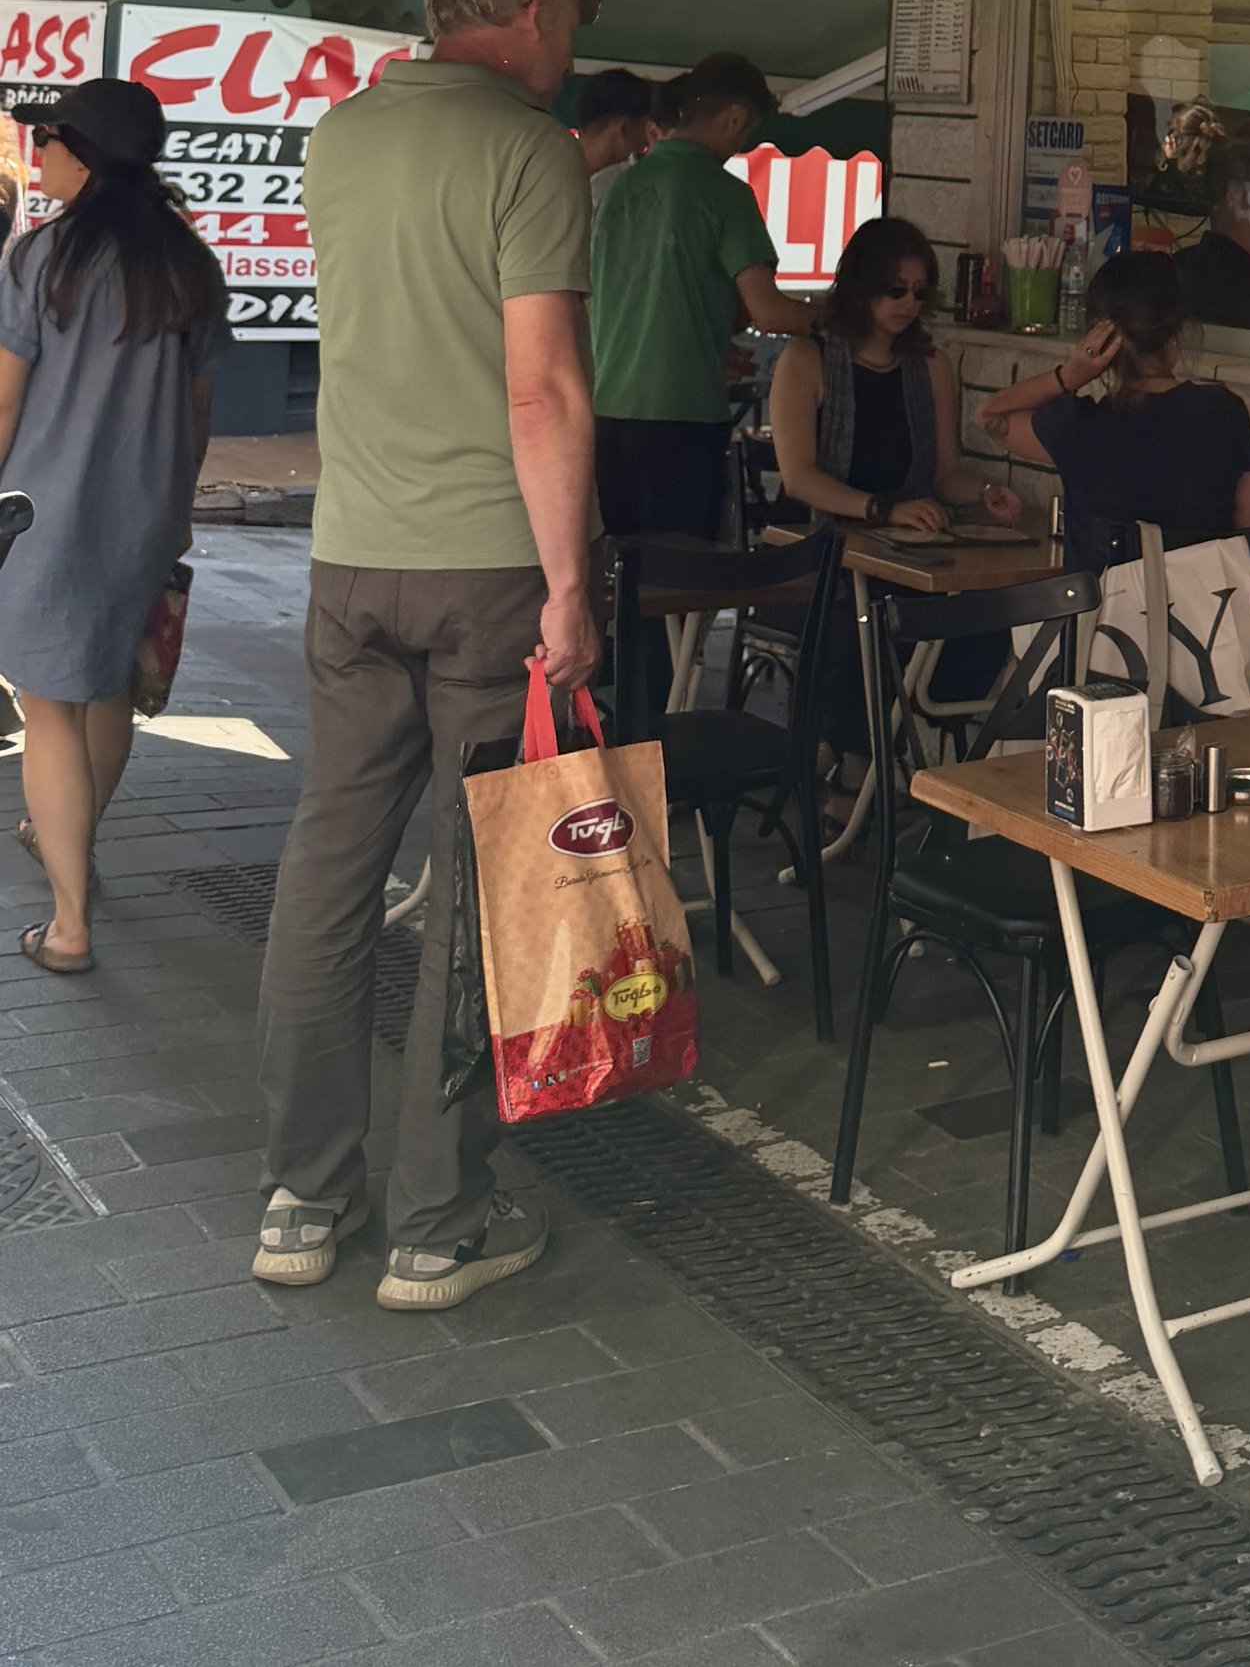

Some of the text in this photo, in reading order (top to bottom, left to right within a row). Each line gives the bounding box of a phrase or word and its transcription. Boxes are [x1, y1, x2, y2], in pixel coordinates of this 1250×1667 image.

[130, 24, 411, 120] CLA
[1028, 120, 1084, 149] SETCARD
[218, 251, 316, 277] lasse
